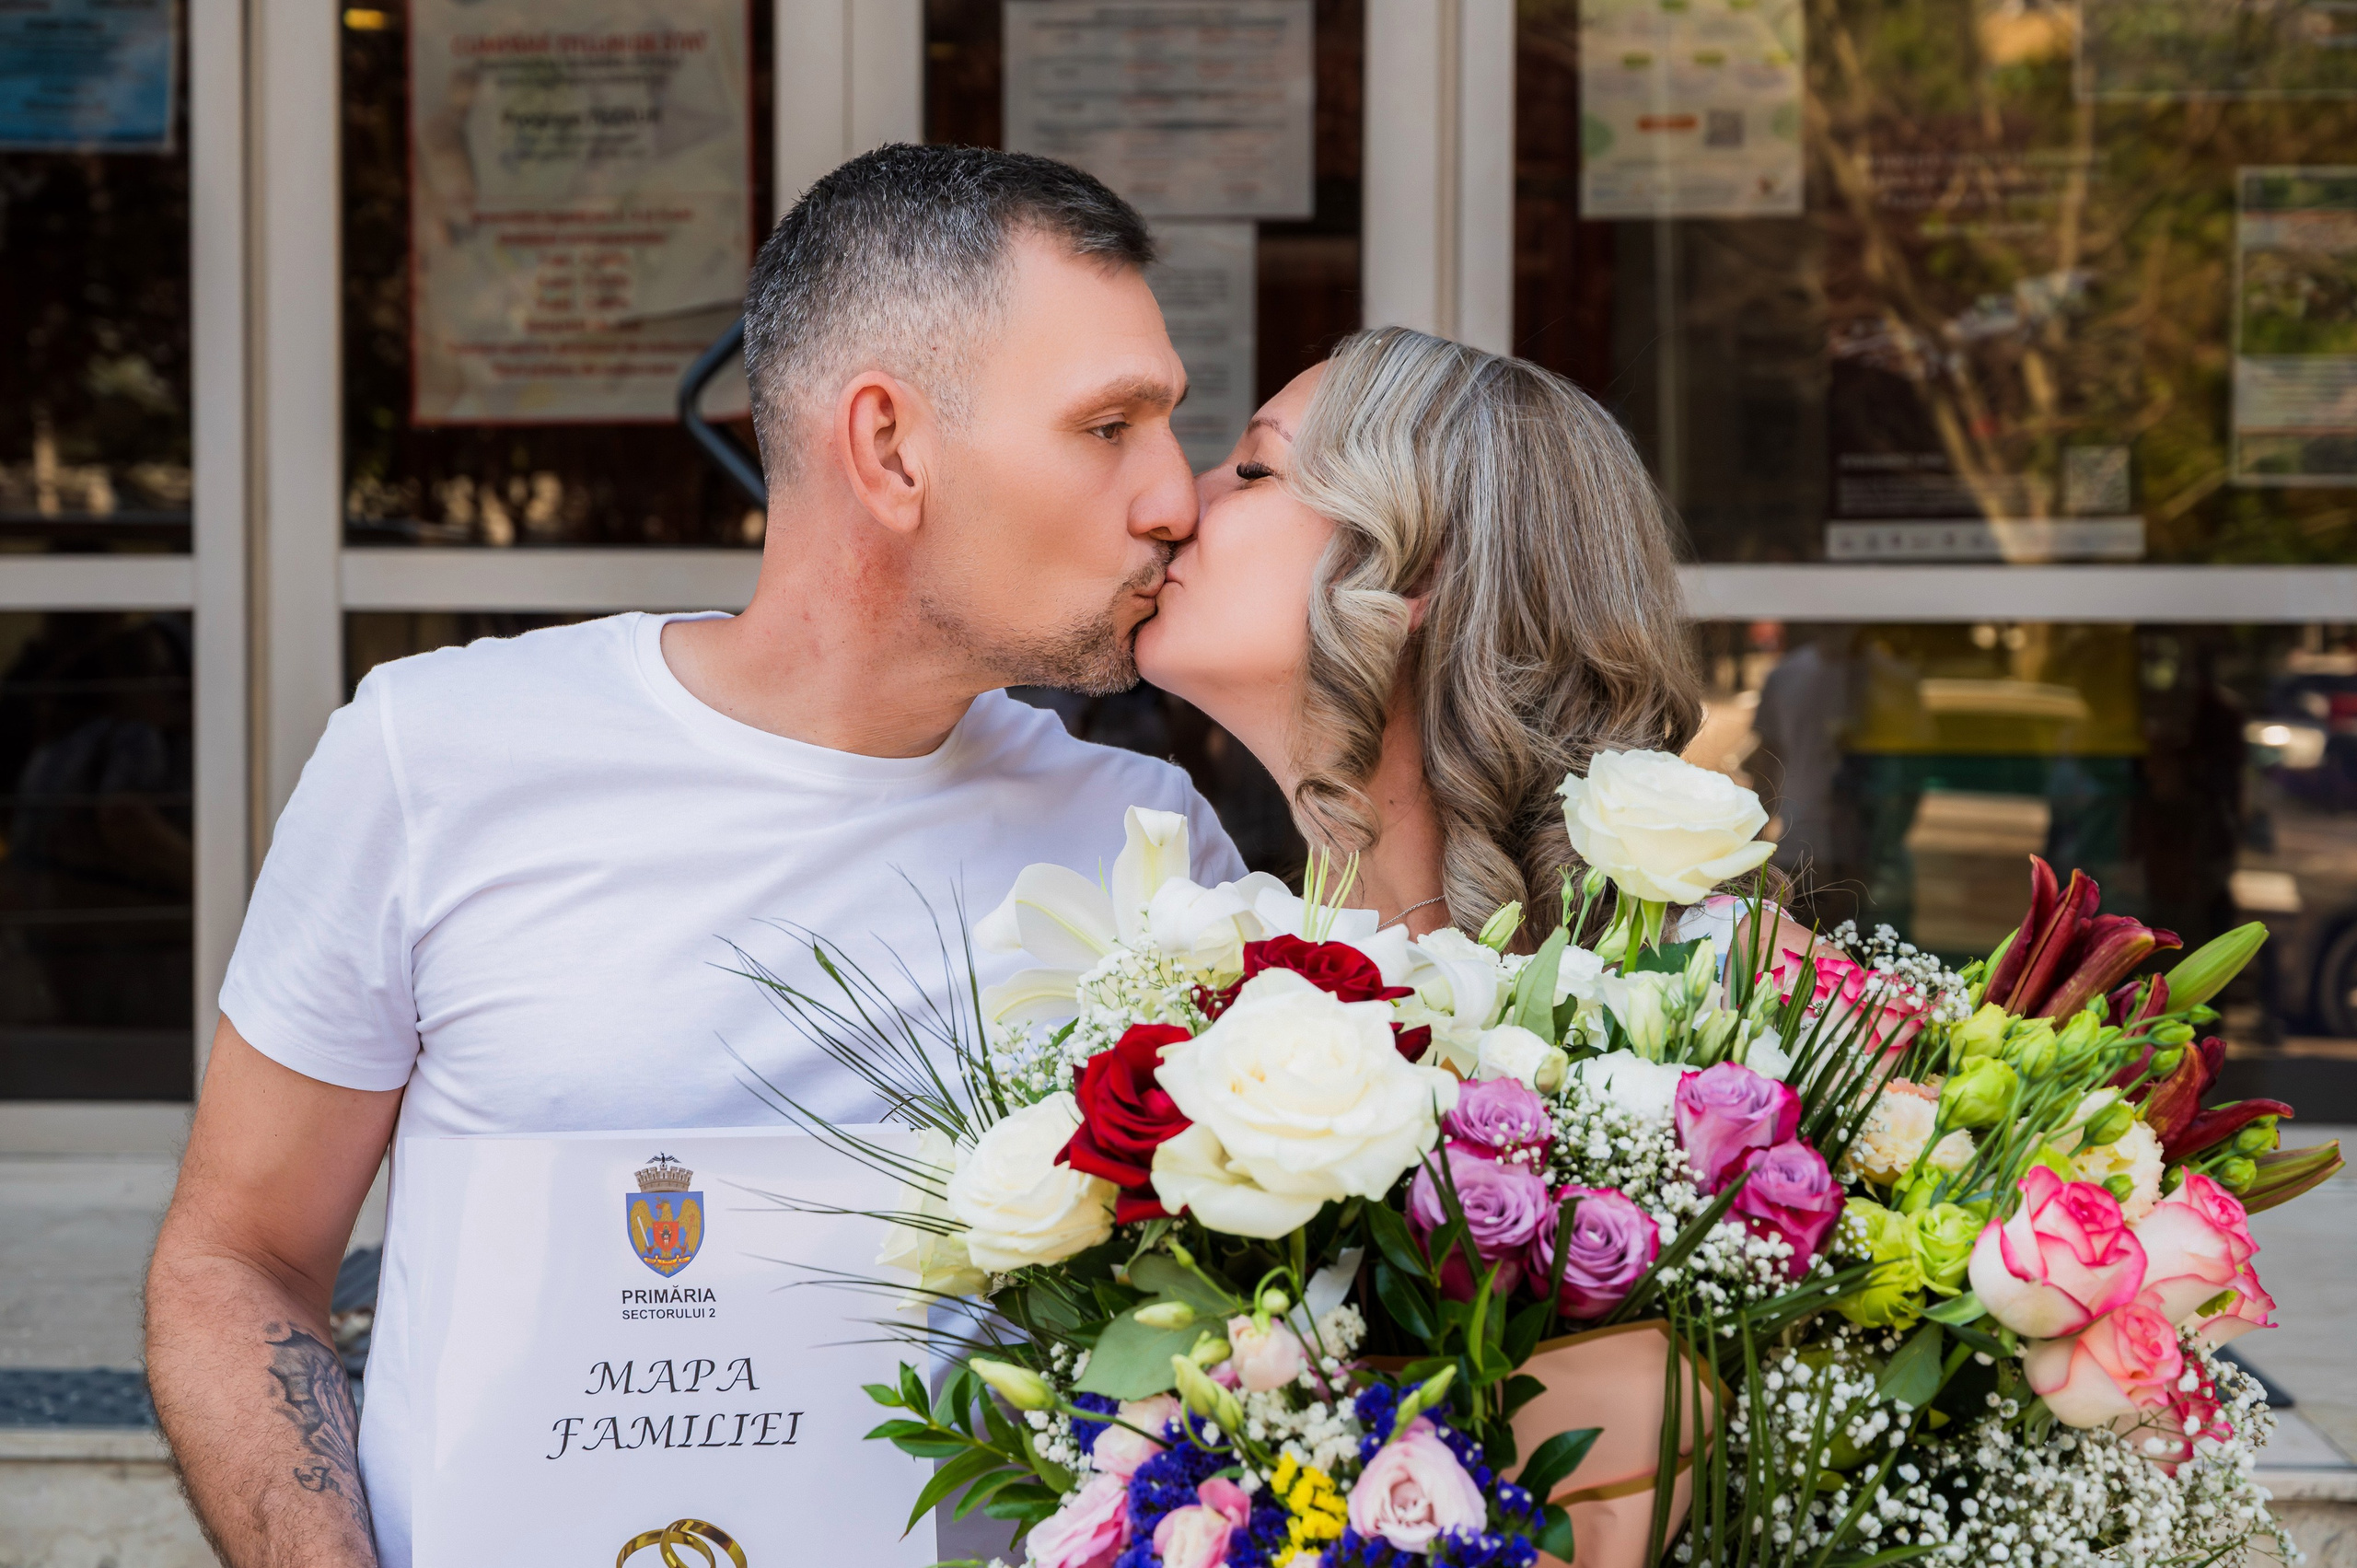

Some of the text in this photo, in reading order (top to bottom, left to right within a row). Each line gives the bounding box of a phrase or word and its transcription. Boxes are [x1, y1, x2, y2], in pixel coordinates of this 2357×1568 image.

[622, 1284, 716, 1304] PRIMĂRIA
[622, 1307, 716, 1319] SECTORULUI 2
[585, 1357, 761, 1395] MAPA
[546, 1411, 806, 1460] FAMILIEI
